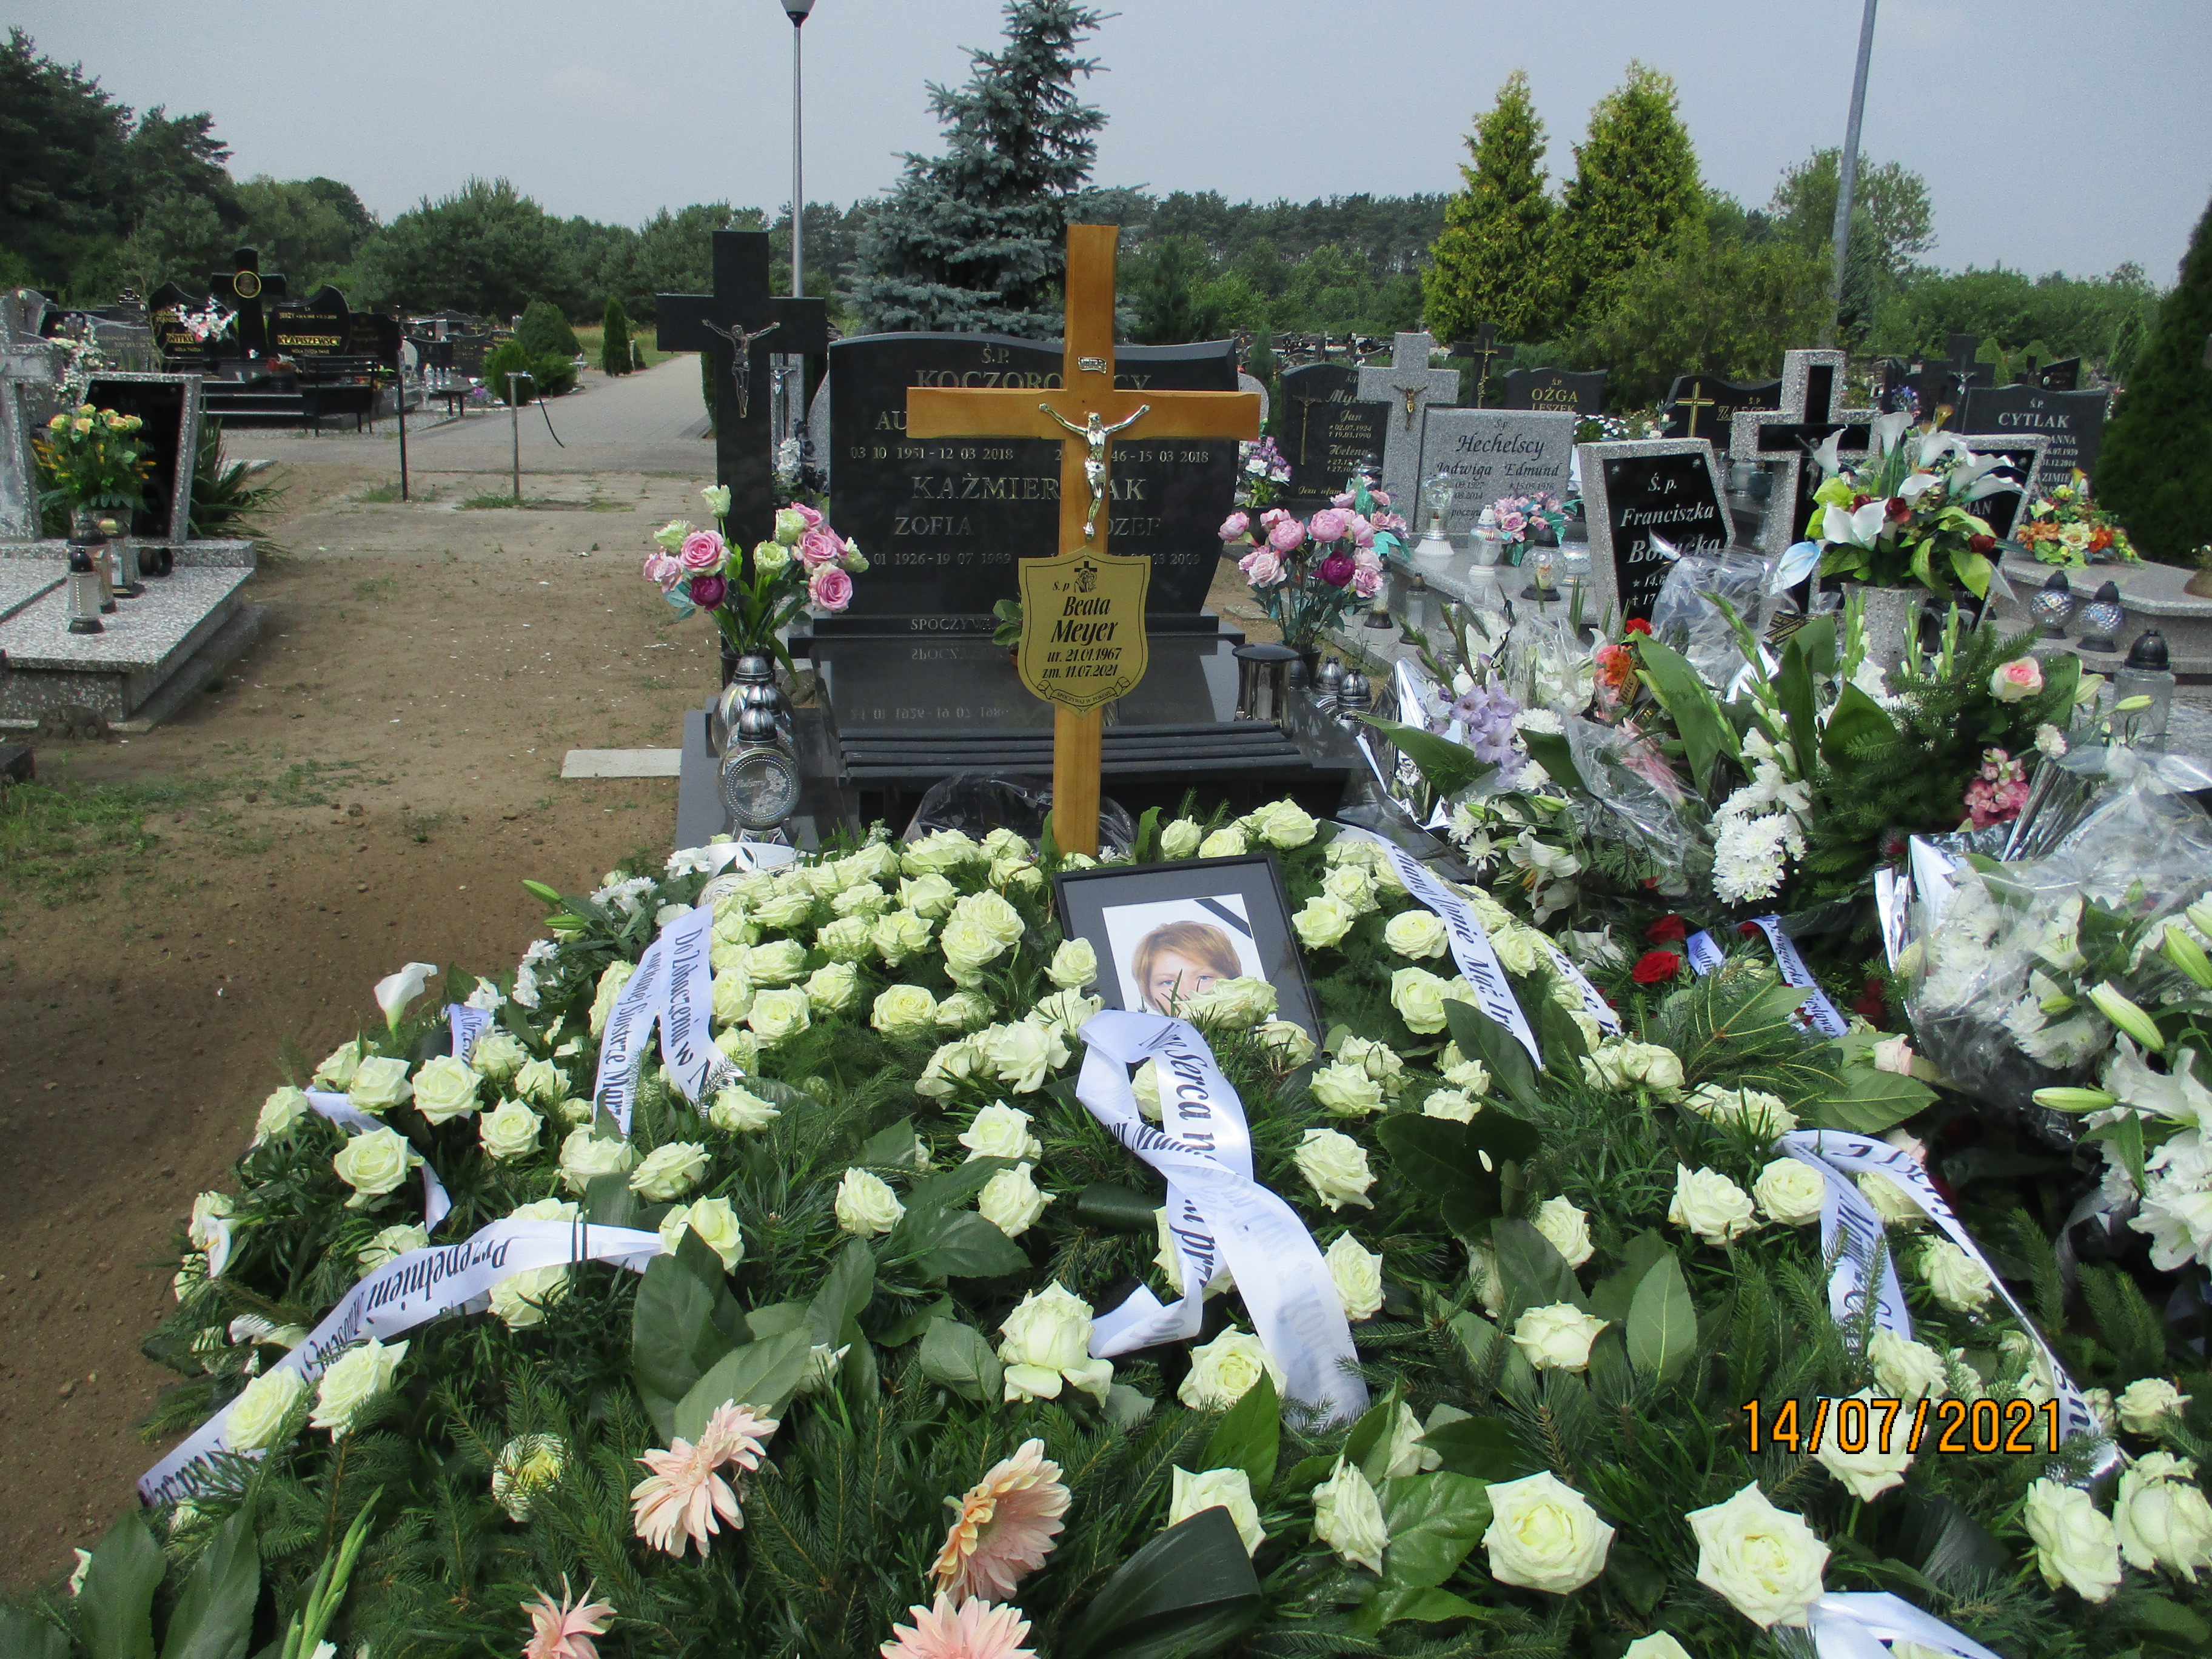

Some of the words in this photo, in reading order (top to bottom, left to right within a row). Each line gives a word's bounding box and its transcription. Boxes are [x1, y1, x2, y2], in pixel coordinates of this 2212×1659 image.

[1531, 386, 1578, 403] OŻGA
[1998, 412, 2070, 428] CYTLAK
[850, 447, 866, 460] 03
[873, 447, 887, 460] 10
[897, 447, 925, 460] 1951
[940, 447, 954, 460] 12
[960, 447, 976, 460] 03
[983, 448, 1014, 460] 2018
[1456, 432, 1546, 461] Hechelscy
[1159, 451, 1174, 463] 03
[1180, 451, 1209, 463] 2018
[1505, 462, 1563, 477] Edmund
[1620, 501, 1715, 527] Franciszka
[894, 516, 974, 535] ZOFIA
[1063, 596, 1111, 617] Beata
[1051, 620, 1119, 646] Meyer
[1047, 652, 1062, 662] ur.
[1065, 648, 1122, 662] 21.01.1967
[1042, 668, 1061, 679] zm.
[1065, 665, 1118, 678] 11.07.2021
[675, 927, 703, 955] Do
